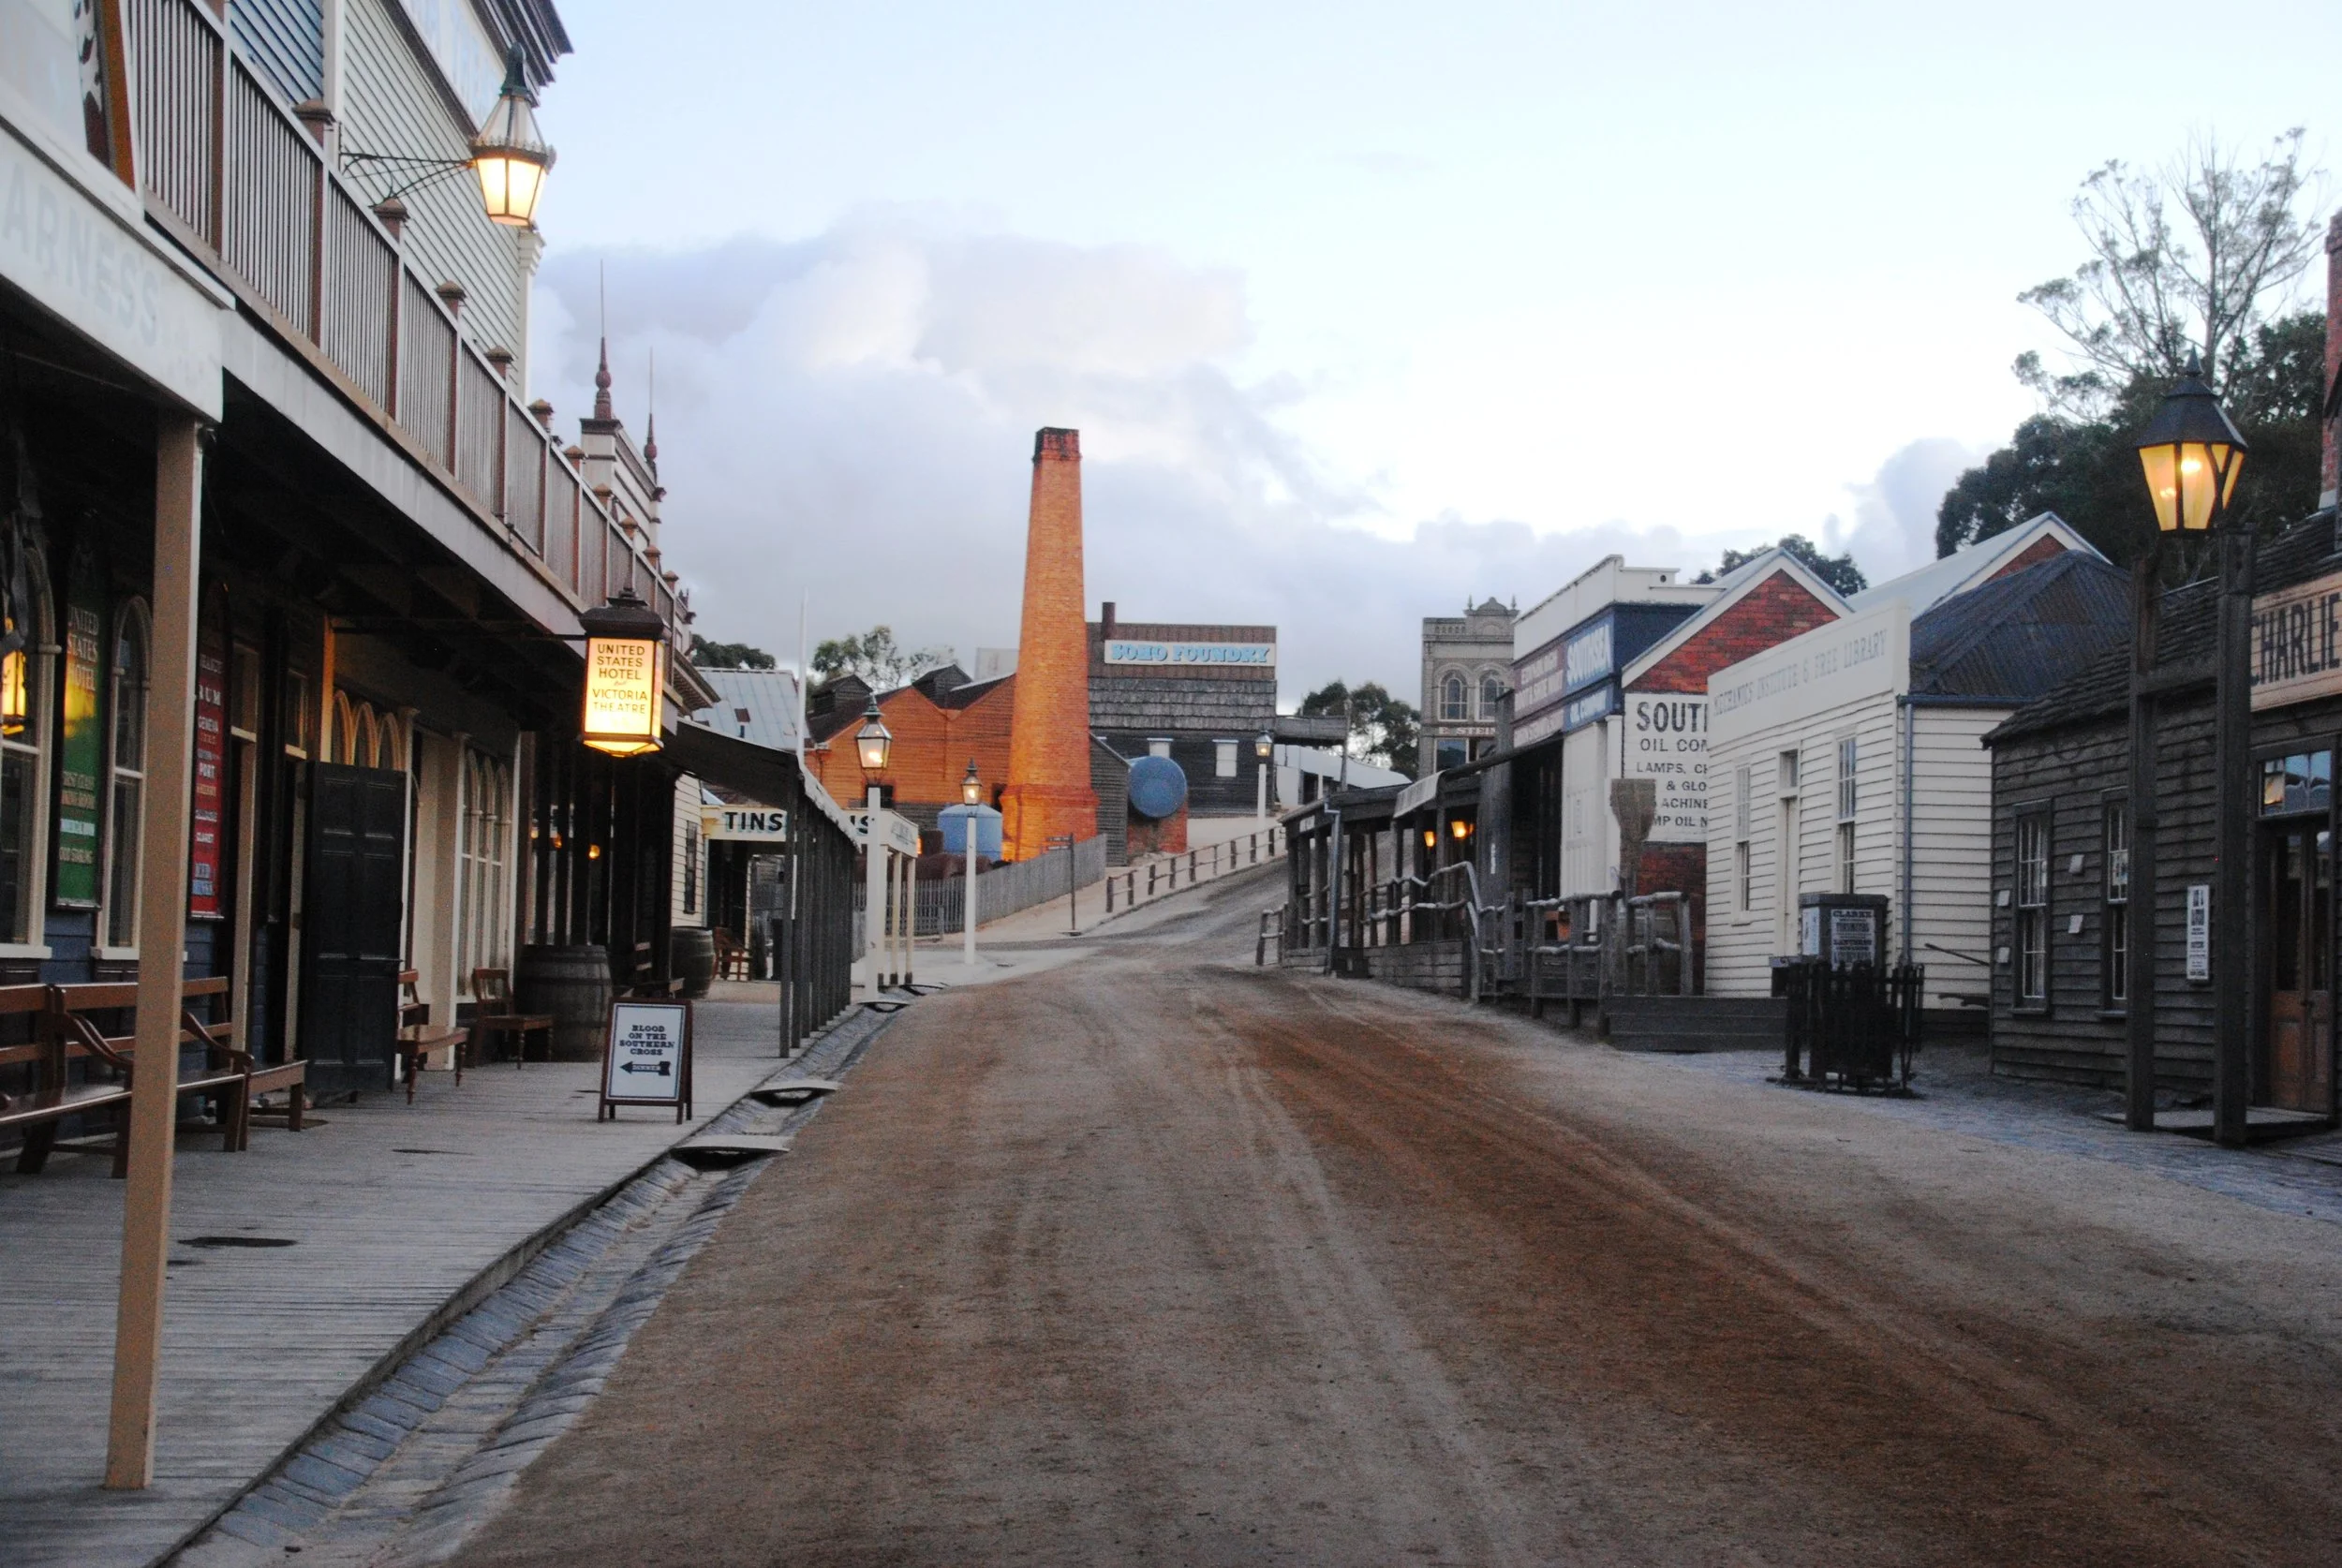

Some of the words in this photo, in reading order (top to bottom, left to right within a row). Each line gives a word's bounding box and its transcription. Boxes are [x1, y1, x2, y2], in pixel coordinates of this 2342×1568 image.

[67, 632, 98, 663] STATES
[597, 643, 645, 657] UNITED
[1111, 643, 1168, 661] SOHO
[1173, 644, 1270, 663] FOUNDRY
[596, 656, 644, 668] STATES
[1566, 625, 1610, 688] SOUTHSEA
[1757, 663, 1798, 700] INSTITUTE
[1815, 648, 1837, 678] FREE
[1844, 629, 1888, 668] LIBRARY
[599, 668, 642, 680] HOTEL
[592, 688, 648, 701] VICTORIA
[593, 702, 646, 715] THEATRE
[1637, 702, 1708, 732] SOUT
[1640, 738, 1668, 752] OIL
[1666, 780, 1677, 791] &
[1675, 816, 1696, 827] OIL
[619, 1040, 675, 1048] SOUTHERN
